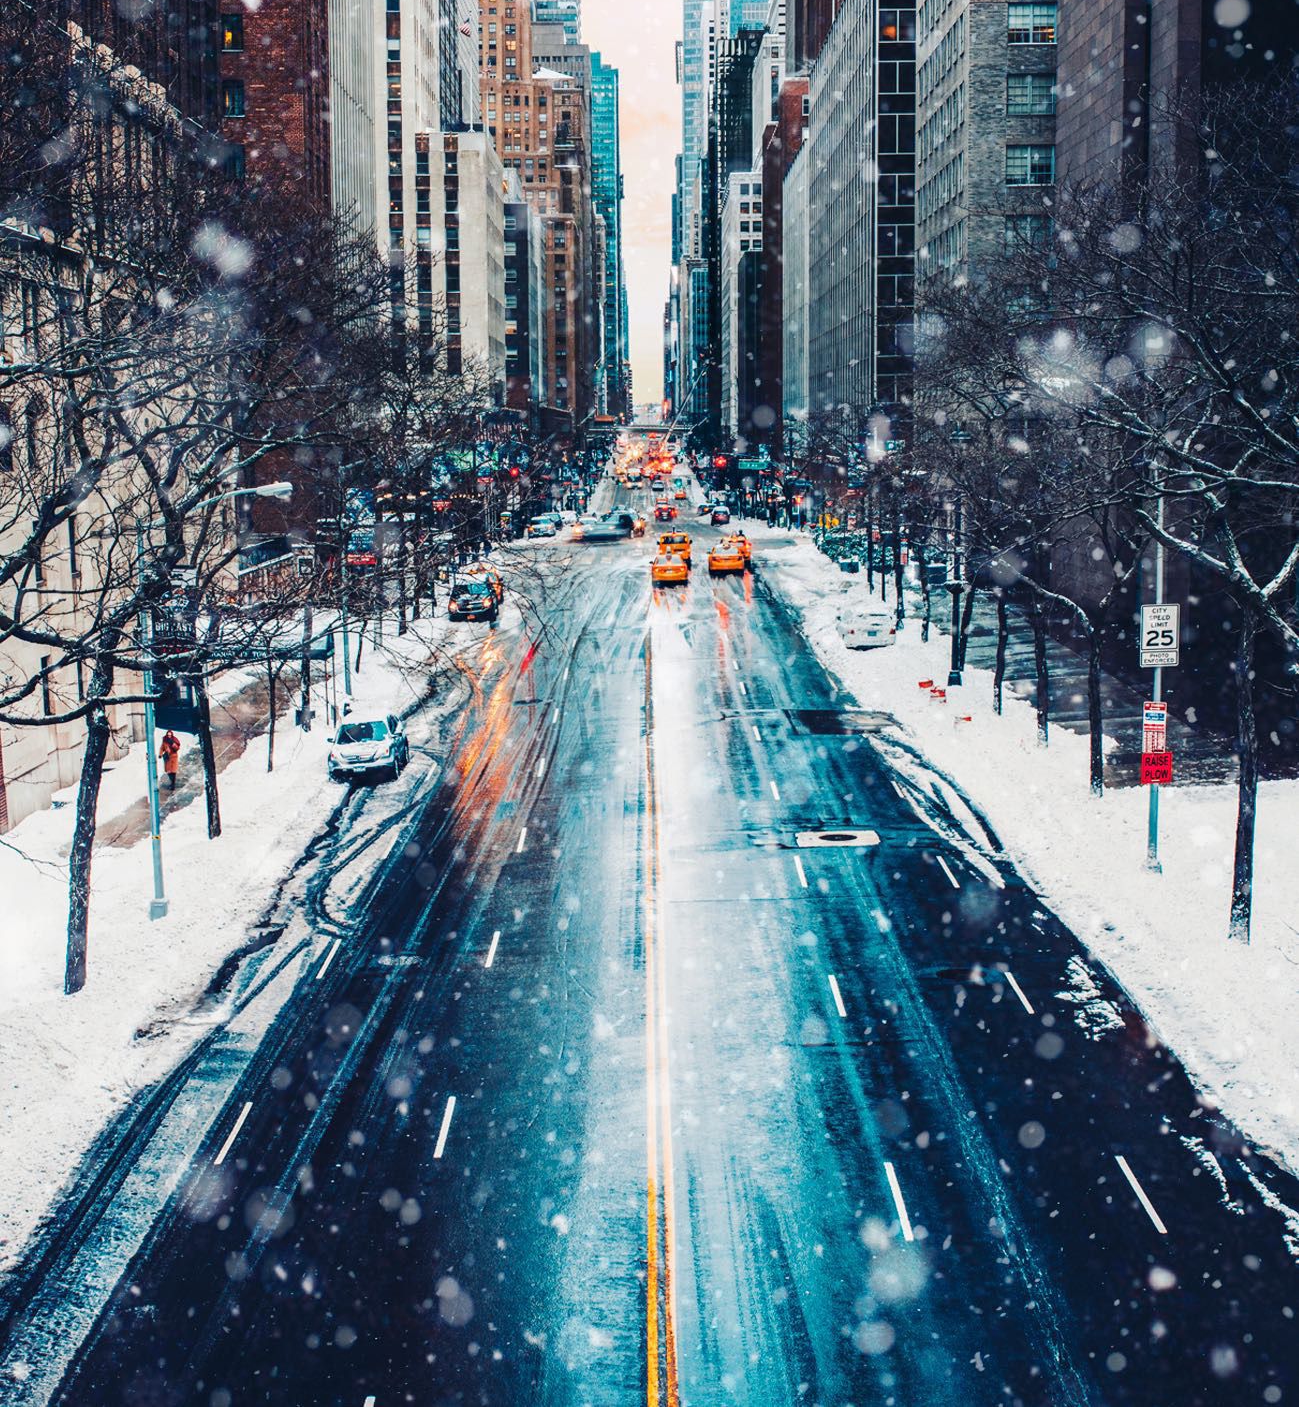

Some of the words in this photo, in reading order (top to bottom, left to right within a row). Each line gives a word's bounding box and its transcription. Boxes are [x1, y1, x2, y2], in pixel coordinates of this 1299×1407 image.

[1146, 629, 1174, 647] 25
[1144, 756, 1169, 766] RAISE
[1144, 769, 1169, 780] PLOW
